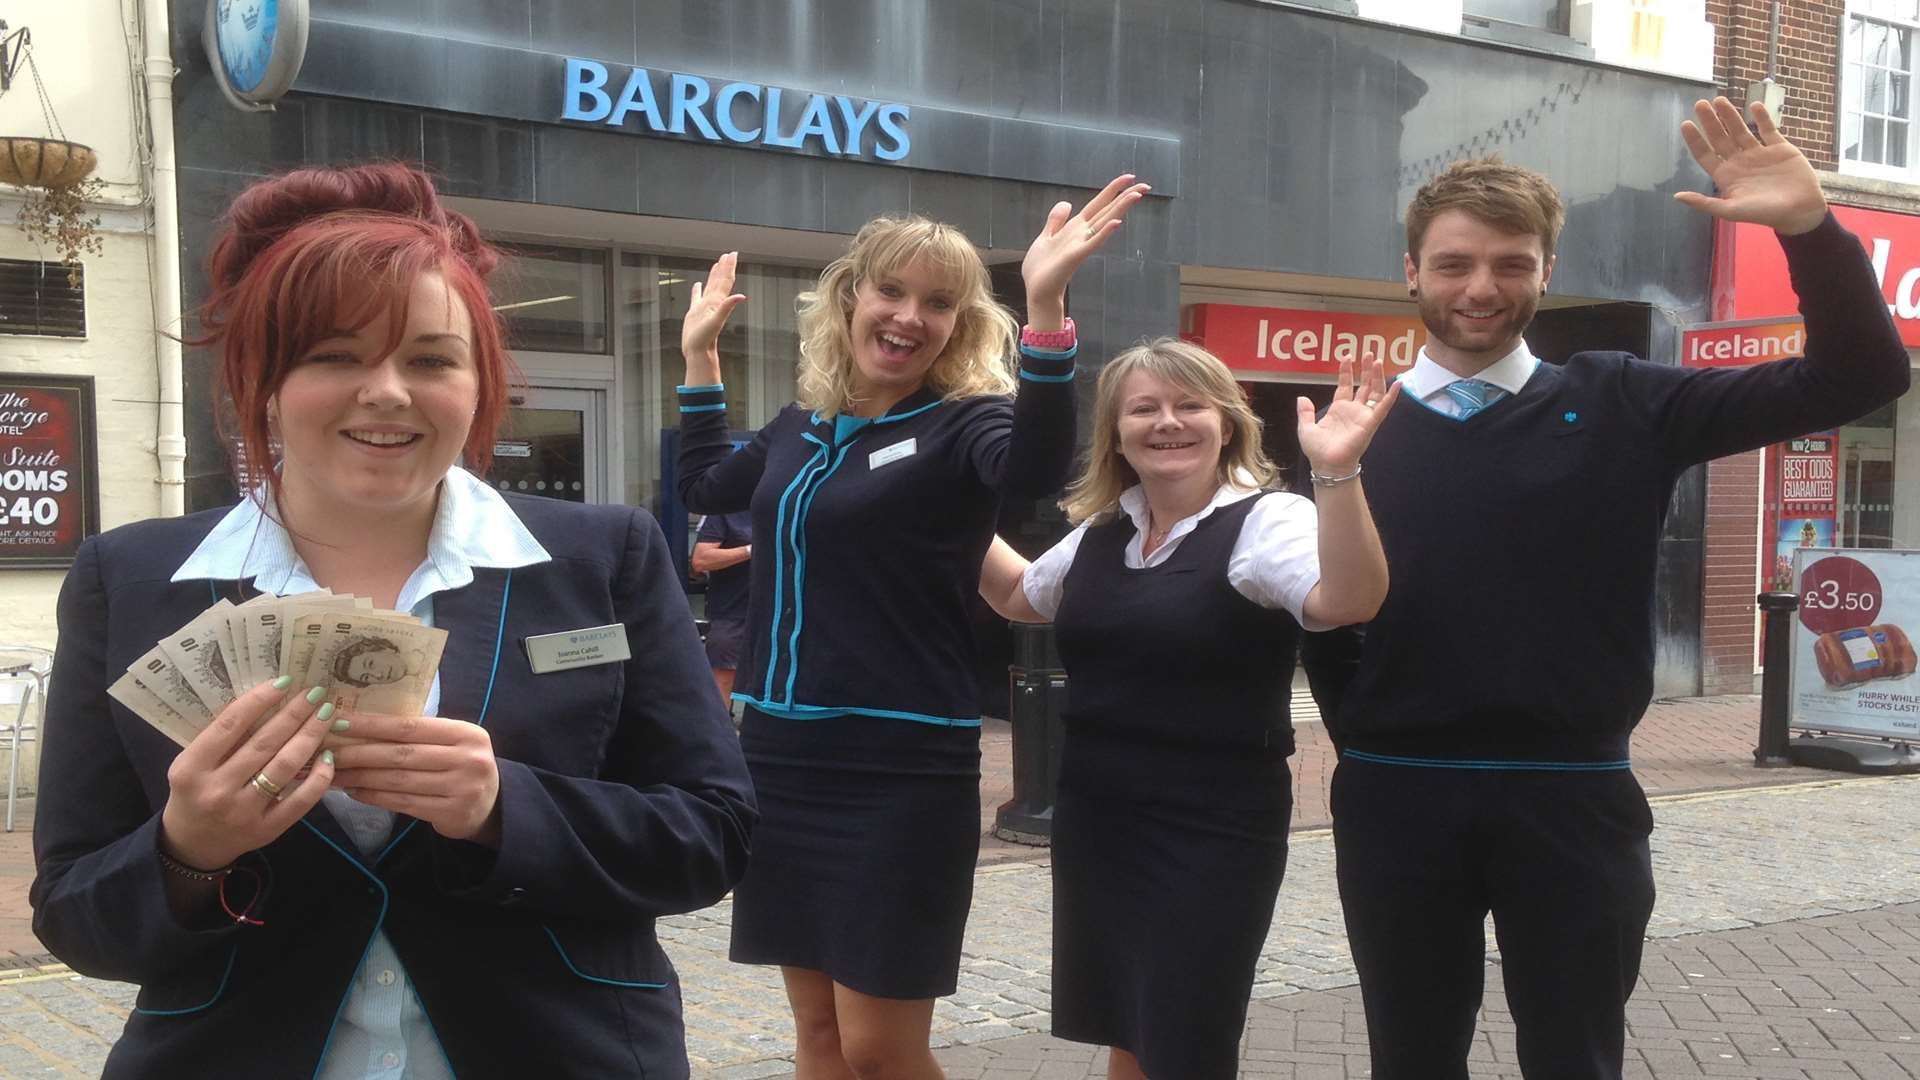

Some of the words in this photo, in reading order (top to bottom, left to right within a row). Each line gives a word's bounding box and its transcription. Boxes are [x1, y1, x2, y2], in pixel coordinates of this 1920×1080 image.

[561, 58, 911, 161] BARCLAYS
[1257, 320, 1416, 366] Iceland
[1691, 330, 1801, 361] Iceland
[0, 425, 23, 436] TEL
[3, 446, 60, 466] Suite
[1804, 439, 1810, 453] 2
[1784, 459, 1807, 479] BEST
[1809, 459, 1833, 479] ODDS
[0, 469, 68, 492] OMS
[1784, 480, 1833, 498] GUARANTEED
[1804, 580, 1874, 611] £3.50
[1857, 701, 1892, 711] STOCKS
[1858, 692, 1888, 701] HURRY
[1890, 693, 1920, 704] WHILE
